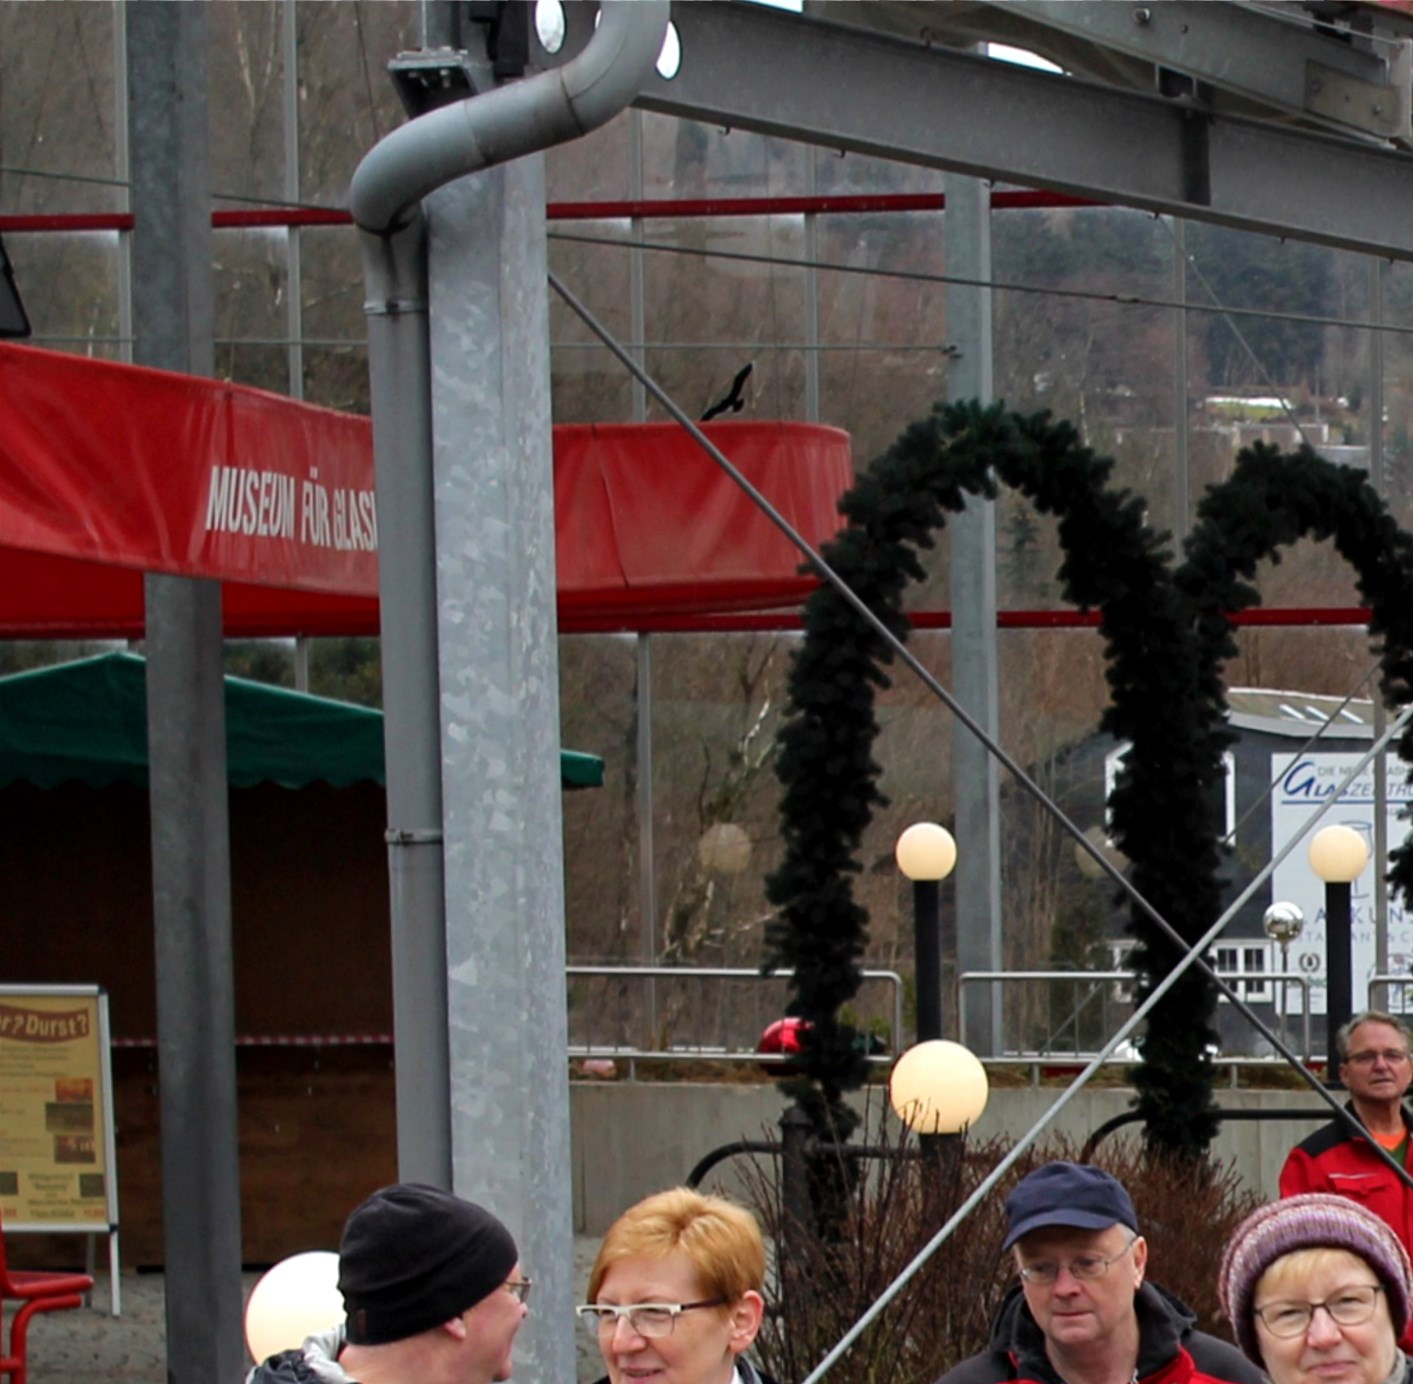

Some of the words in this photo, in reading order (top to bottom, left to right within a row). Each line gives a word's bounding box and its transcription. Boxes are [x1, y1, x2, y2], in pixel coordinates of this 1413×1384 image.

[205, 465, 295, 540] MUSEUM
[301, 466, 331, 548] FÜR
[334, 488, 378, 552] GLAS
[26, 1013, 87, 1037] Durst?
